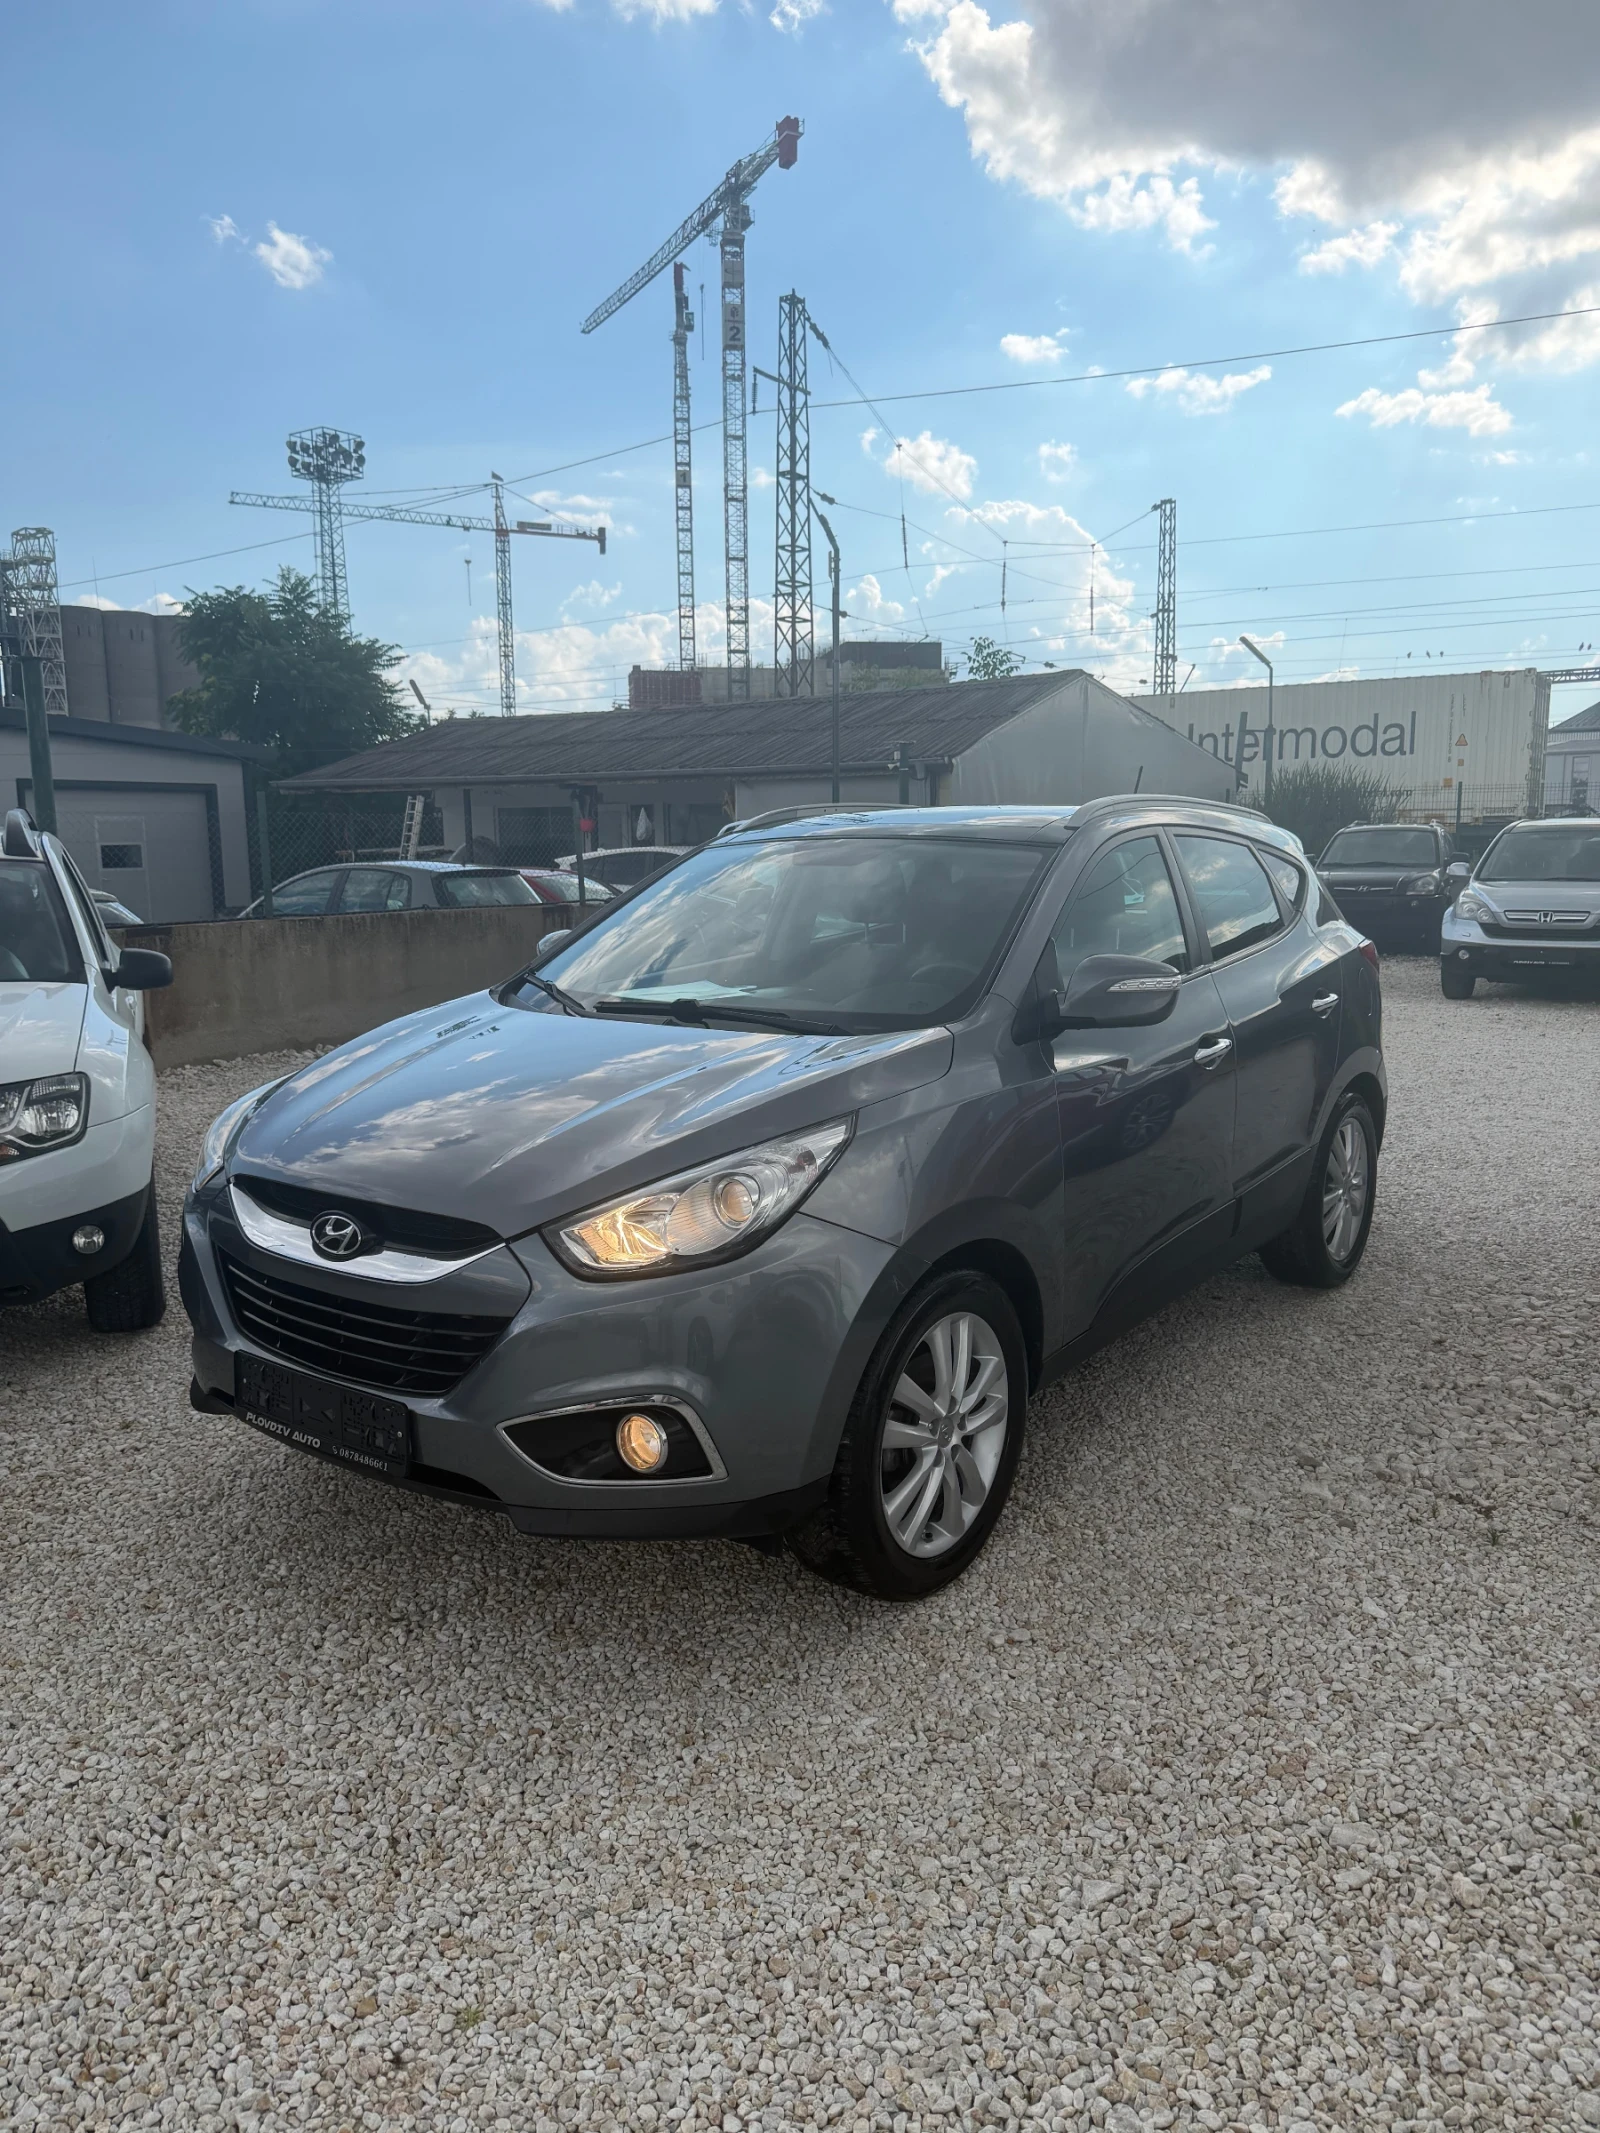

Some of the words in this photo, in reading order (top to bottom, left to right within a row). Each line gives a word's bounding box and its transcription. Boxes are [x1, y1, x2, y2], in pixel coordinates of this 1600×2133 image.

[728, 325, 742, 342] 2
[679, 471, 687, 483] 1
[245, 1411, 291, 1437] PLOVDIV
[291, 1430, 321, 1449] AUTO
